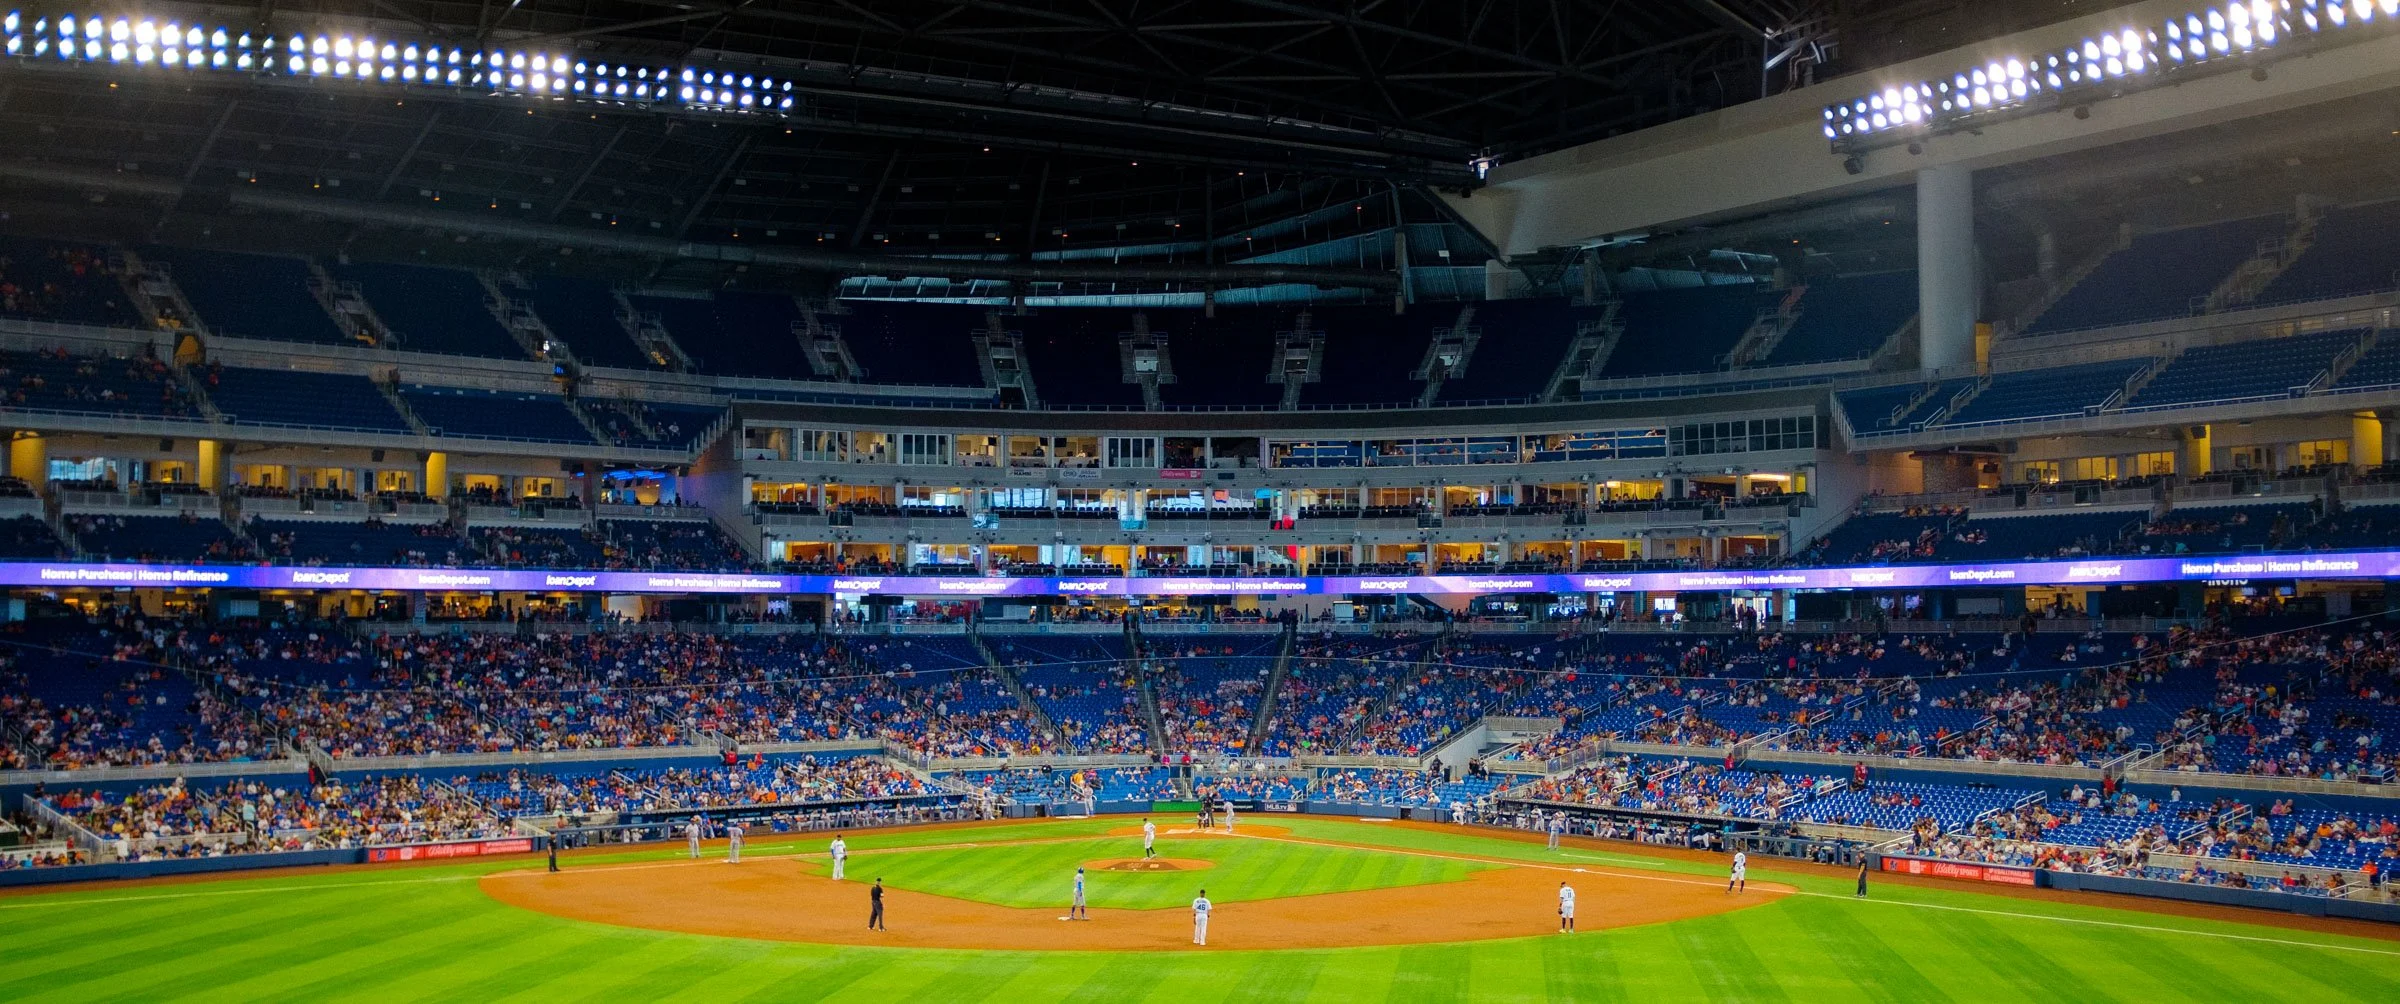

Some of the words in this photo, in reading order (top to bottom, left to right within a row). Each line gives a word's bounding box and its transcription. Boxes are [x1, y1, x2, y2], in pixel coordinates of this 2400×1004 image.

[2182, 564, 2212, 574] Home
[2214, 562, 2263, 574] Purchase
[2268, 561, 2301, 572] Home
[2301, 560, 2359, 571] Refinance
[41, 568, 77, 580] Home
[78, 569, 132, 580] Purchase
[138, 570, 171, 581] Home
[173, 570, 228, 582] Refinance
[293, 571, 350, 584] loanDepot
[418, 574, 490, 586] loanDepot.com
[1680, 578, 1704, 586] Home
[1705, 576, 1742, 585] Purchase
[1747, 576, 1769, 584] Home
[1769, 575, 1806, 584] Refinance
[1950, 570, 2015, 581] loanDepot.com
[546, 575, 596, 587] loanDepot
[649, 578, 674, 587] Home
[674, 578, 713, 588] Purchase
[717, 579, 741, 588] Home
[741, 580, 781, 588] Refinance
[834, 580, 882, 591] loanDepot
[939, 581, 1006, 591] loanDepot.com
[1059, 581, 1109, 591] loanDepot
[1163, 582, 1189, 590] Home
[1190, 582, 1231, 591] Purchase
[1235, 582, 1261, 590] Home
[1262, 581, 1306, 590] Refinance
[1360, 579, 1409, 590] loanDepot
[1469, 580, 1533, 590] loanDepot.com
[1585, 578, 1632, 588] loanDepot
[427, 845, 455, 857] Bally
[1934, 863, 1959, 878] Bally
[1960, 868, 1979, 877] SPORTS
